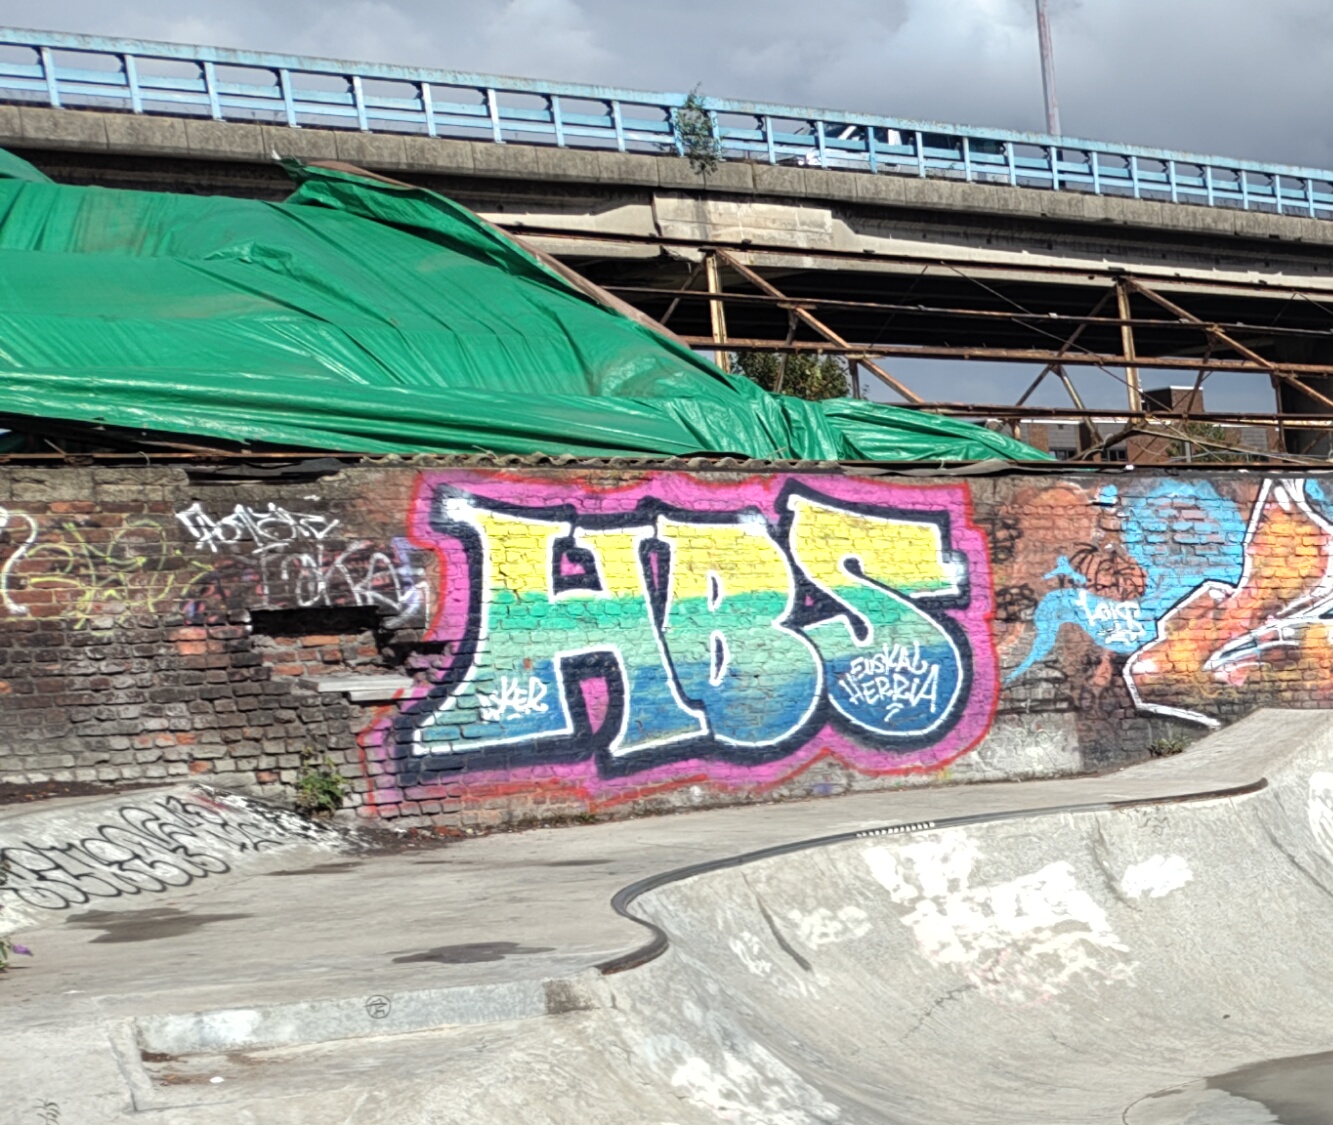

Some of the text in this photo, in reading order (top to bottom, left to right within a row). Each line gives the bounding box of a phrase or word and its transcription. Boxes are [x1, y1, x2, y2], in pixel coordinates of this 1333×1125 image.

[412, 488, 968, 760] HBS
[850, 639, 928, 681] EUSKAL
[839, 664, 940, 713] HERRIA
